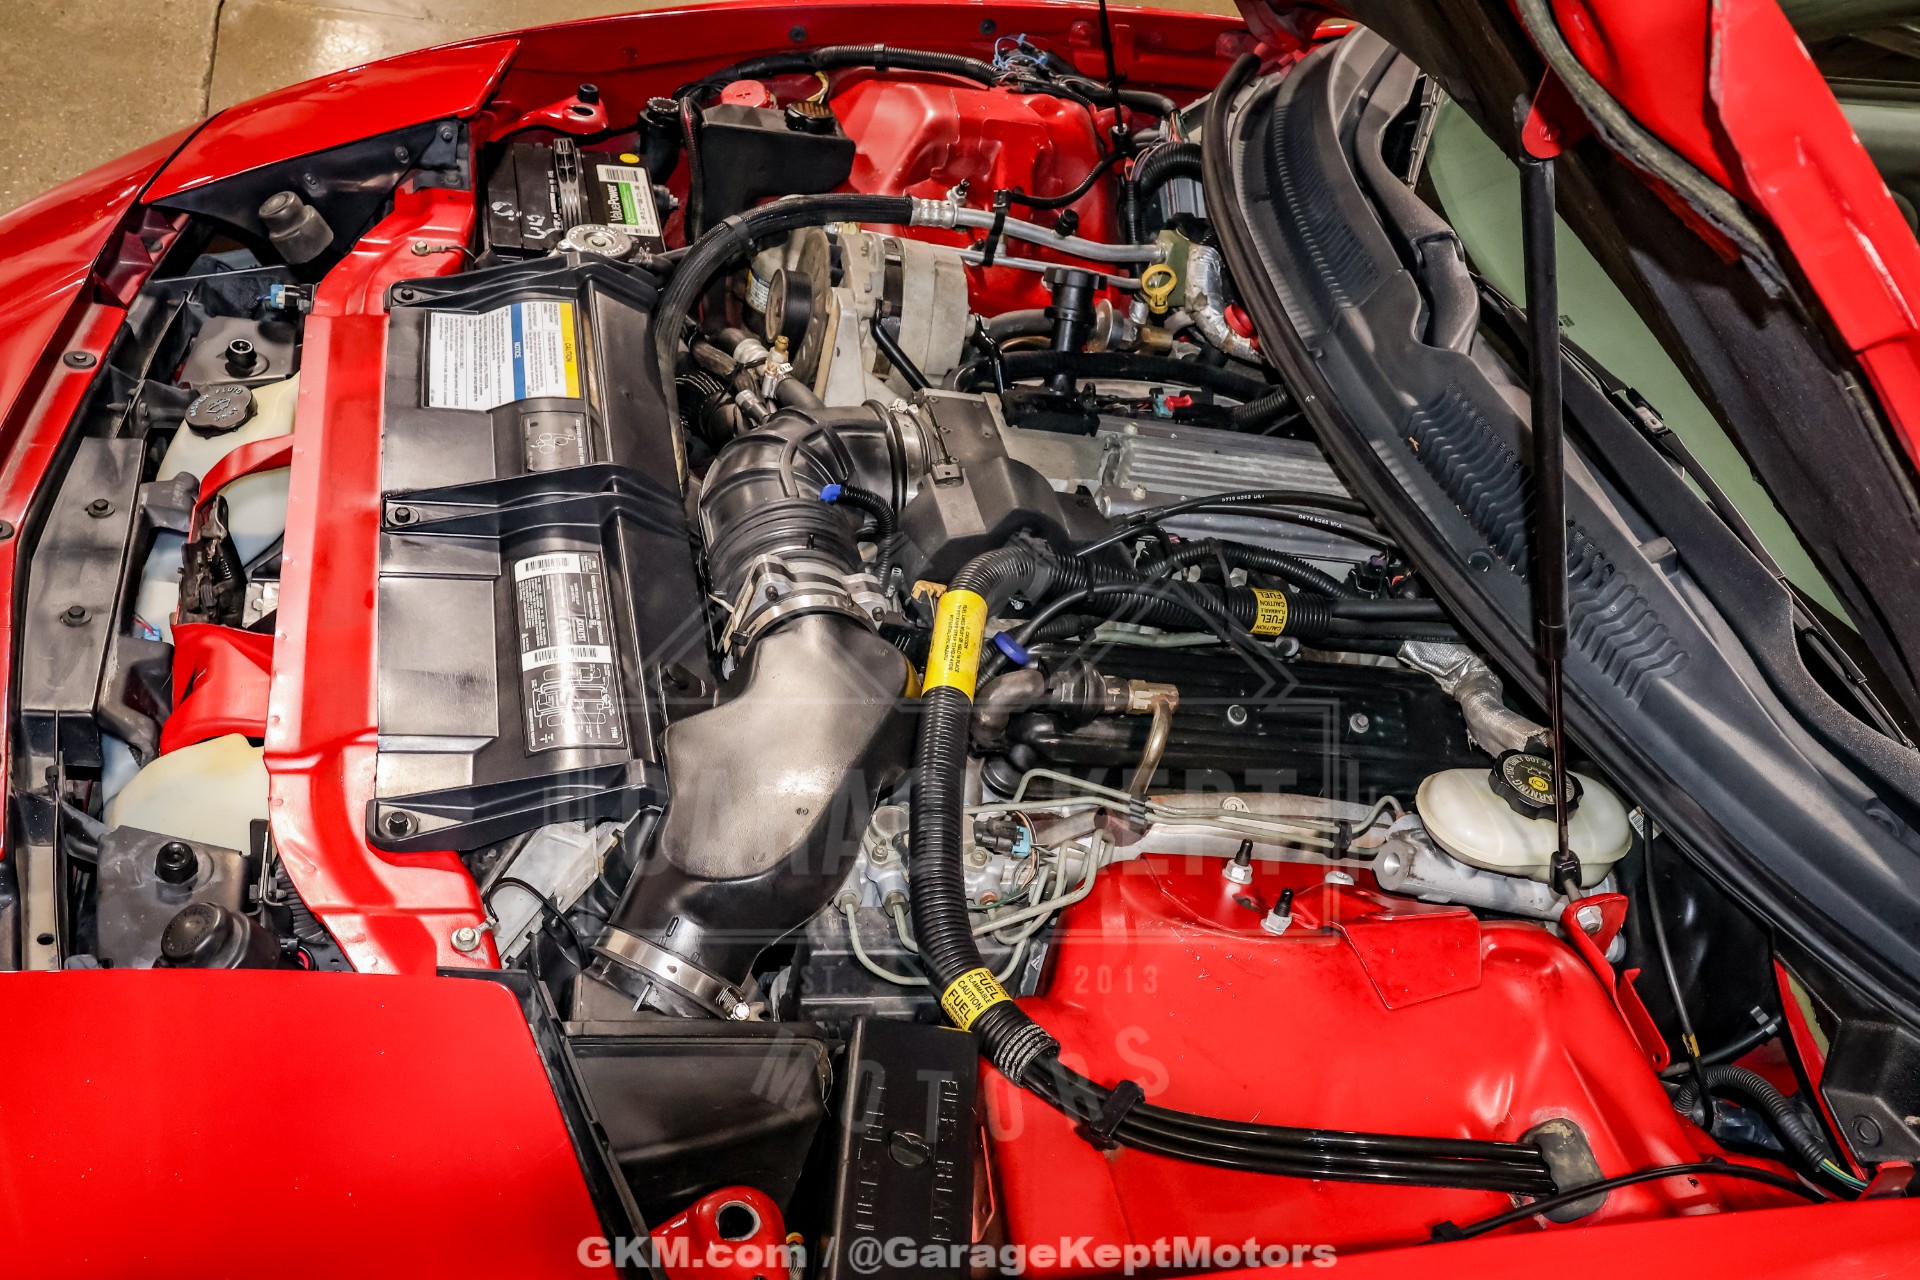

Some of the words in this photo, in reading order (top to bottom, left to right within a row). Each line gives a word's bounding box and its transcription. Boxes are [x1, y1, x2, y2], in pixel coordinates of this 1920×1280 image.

[606, 184, 623, 222] ValuePower
[1258, 592, 1282, 600] FUEL
[576, 619, 586, 642] CATALYST
[1260, 614, 1284, 624] FUEL
[1512, 778, 1555, 802] ARNING
[958, 980, 984, 1010] CAUTION
[966, 974, 992, 1004] FLAMMABLE
[974, 972, 998, 1000] FUEL
[944, 996, 967, 1026] FLAMMABLE
[948, 988, 972, 1021] FUEL
